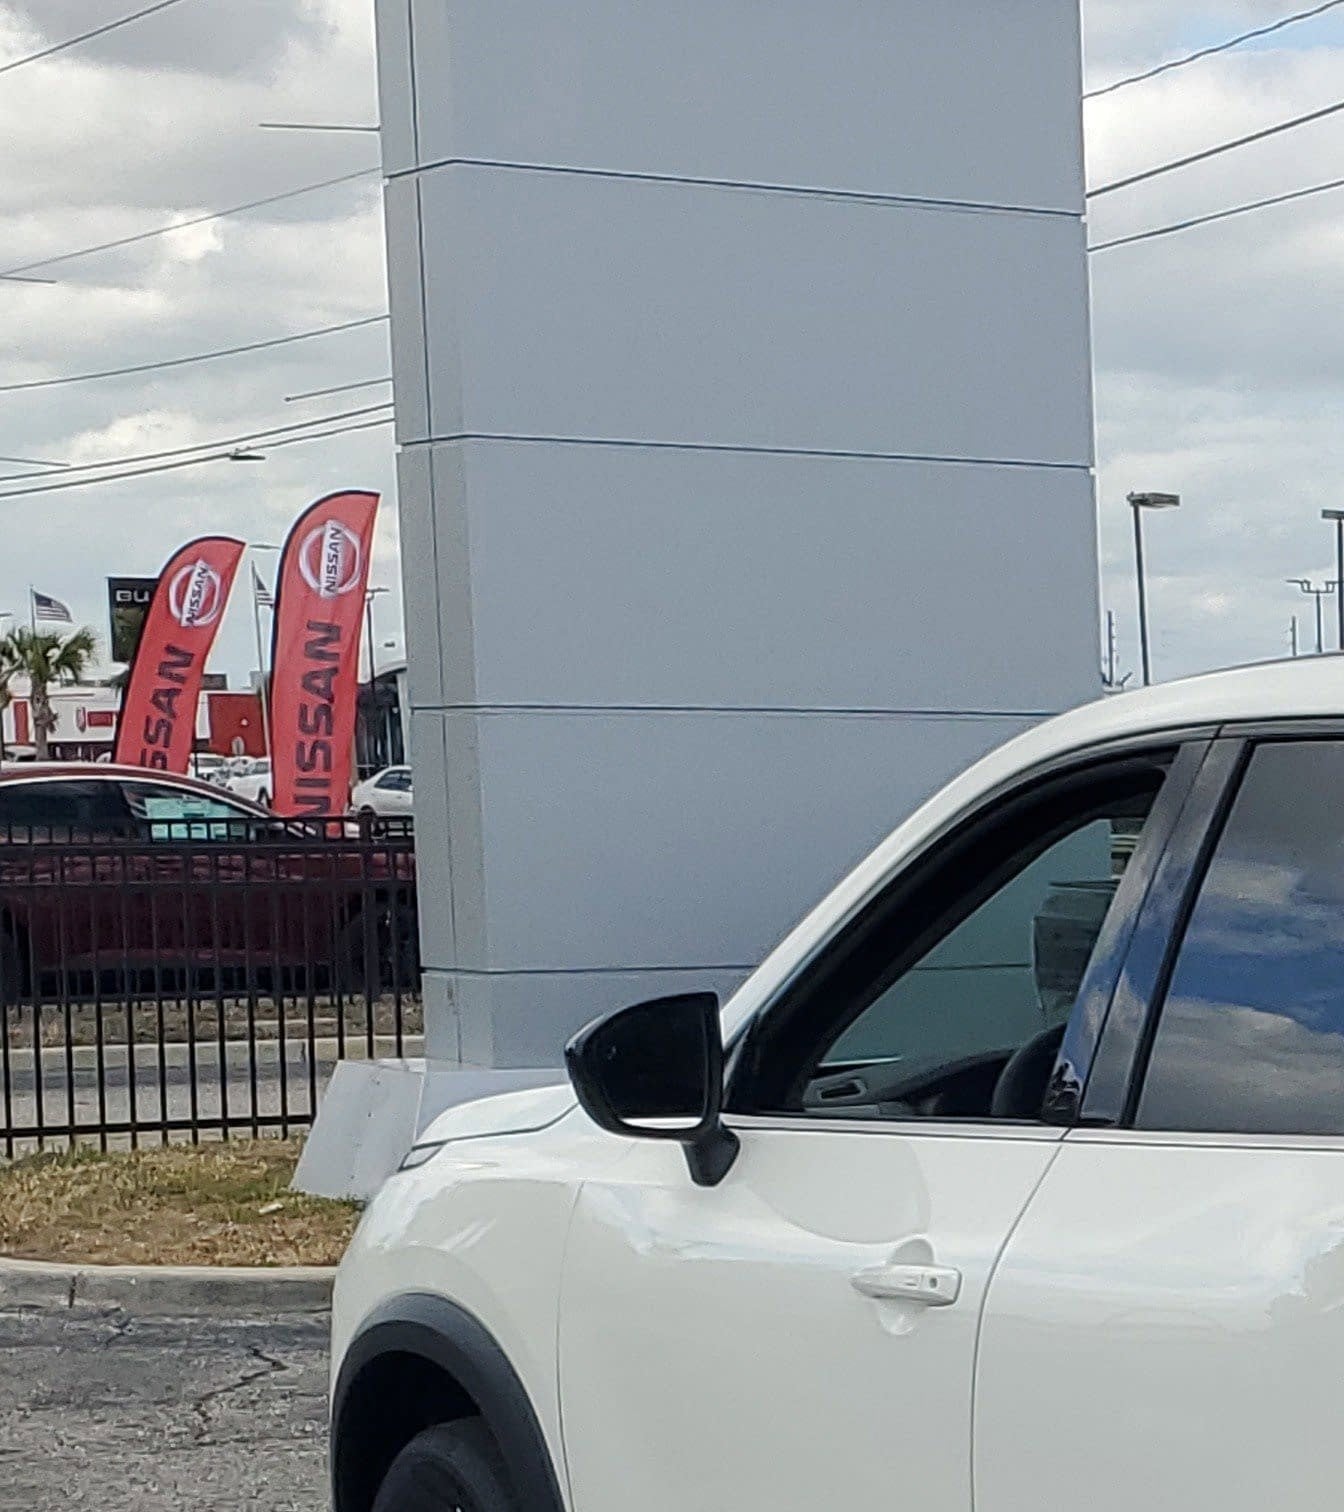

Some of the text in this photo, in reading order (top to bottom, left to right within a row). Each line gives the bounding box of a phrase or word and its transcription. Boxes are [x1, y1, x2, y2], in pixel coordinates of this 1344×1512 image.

[324, 525, 343, 594] NISSAN
[116, 589, 151, 603] BU
[184, 565, 210, 625] NISSAN
[141, 642, 196, 771] SSAN
